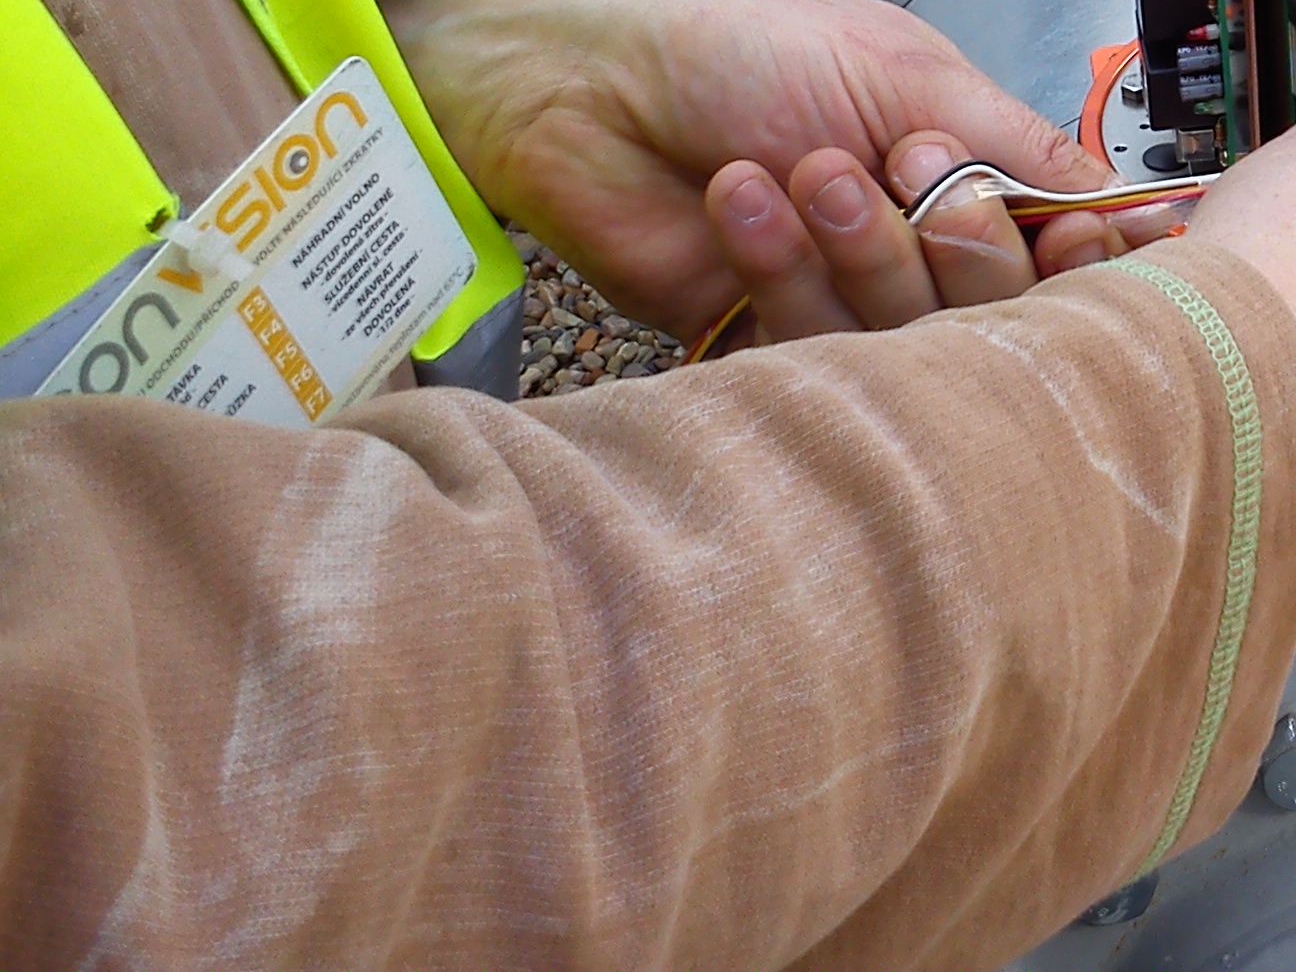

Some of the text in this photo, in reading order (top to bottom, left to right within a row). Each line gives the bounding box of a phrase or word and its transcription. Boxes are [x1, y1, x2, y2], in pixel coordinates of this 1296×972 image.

[252, 235, 283, 267] VOLTE
[342, 126, 385, 175] ZKRATKY
[292, 173, 380, 268] NÁHRADNÍ VOLNO
[301, 187, 394, 289] NÁSTUP DOVOLENÉ
[383, 231, 405, 257] cesta
[324, 220, 400, 305] SLUŽEBNÍ CESTA
[325, 237, 365, 281] dovolená
[356, 261, 395, 306] NÁVRAT
[427, 289, 443, 311] nad
[243, 295, 267, 323] F3
[363, 275, 417, 337] DOVOLENÁ
[394, 299, 411, 319] dne
[260, 318, 282, 346] F4
[275, 341, 298, 368] F5
[165, 363, 202, 403] TÁVKA
[291, 363, 313, 392] F6
[306, 386, 325, 414] F7
